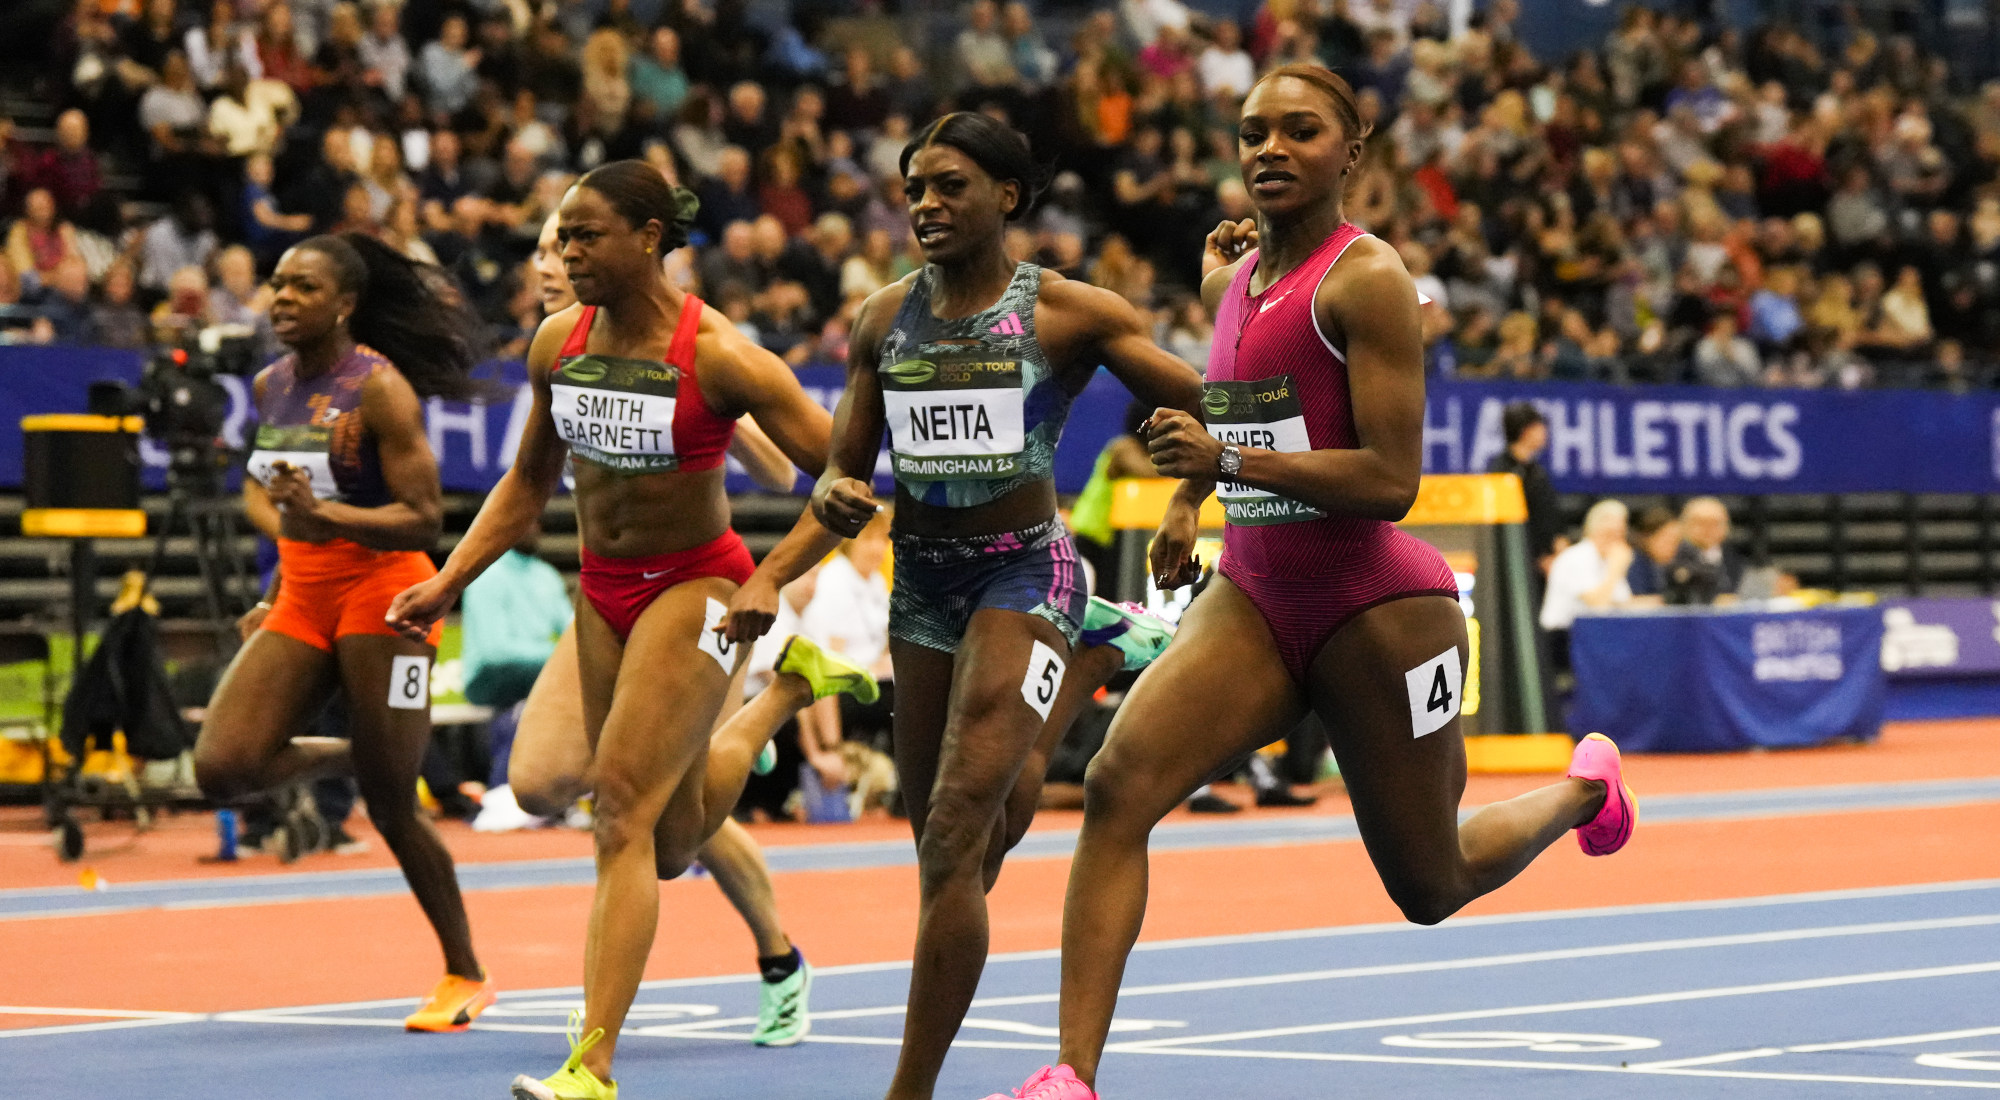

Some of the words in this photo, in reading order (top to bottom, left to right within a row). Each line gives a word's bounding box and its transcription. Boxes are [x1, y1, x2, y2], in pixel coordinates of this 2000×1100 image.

[985, 361, 1016, 372] TOUR
[576, 394, 644, 423] SMITH
[1256, 387, 1289, 404] TOUR
[562, 418, 662, 451] BARNETT
[909, 404, 994, 441] NEITA
[1469, 397, 1802, 479] AHLETICS
[899, 458, 992, 475] BIRMINGHAM
[996, 456, 1014, 472] 23
[403, 665, 420, 699] 8
[1037, 658, 1058, 705] 5
[1426, 663, 1453, 714] 4
